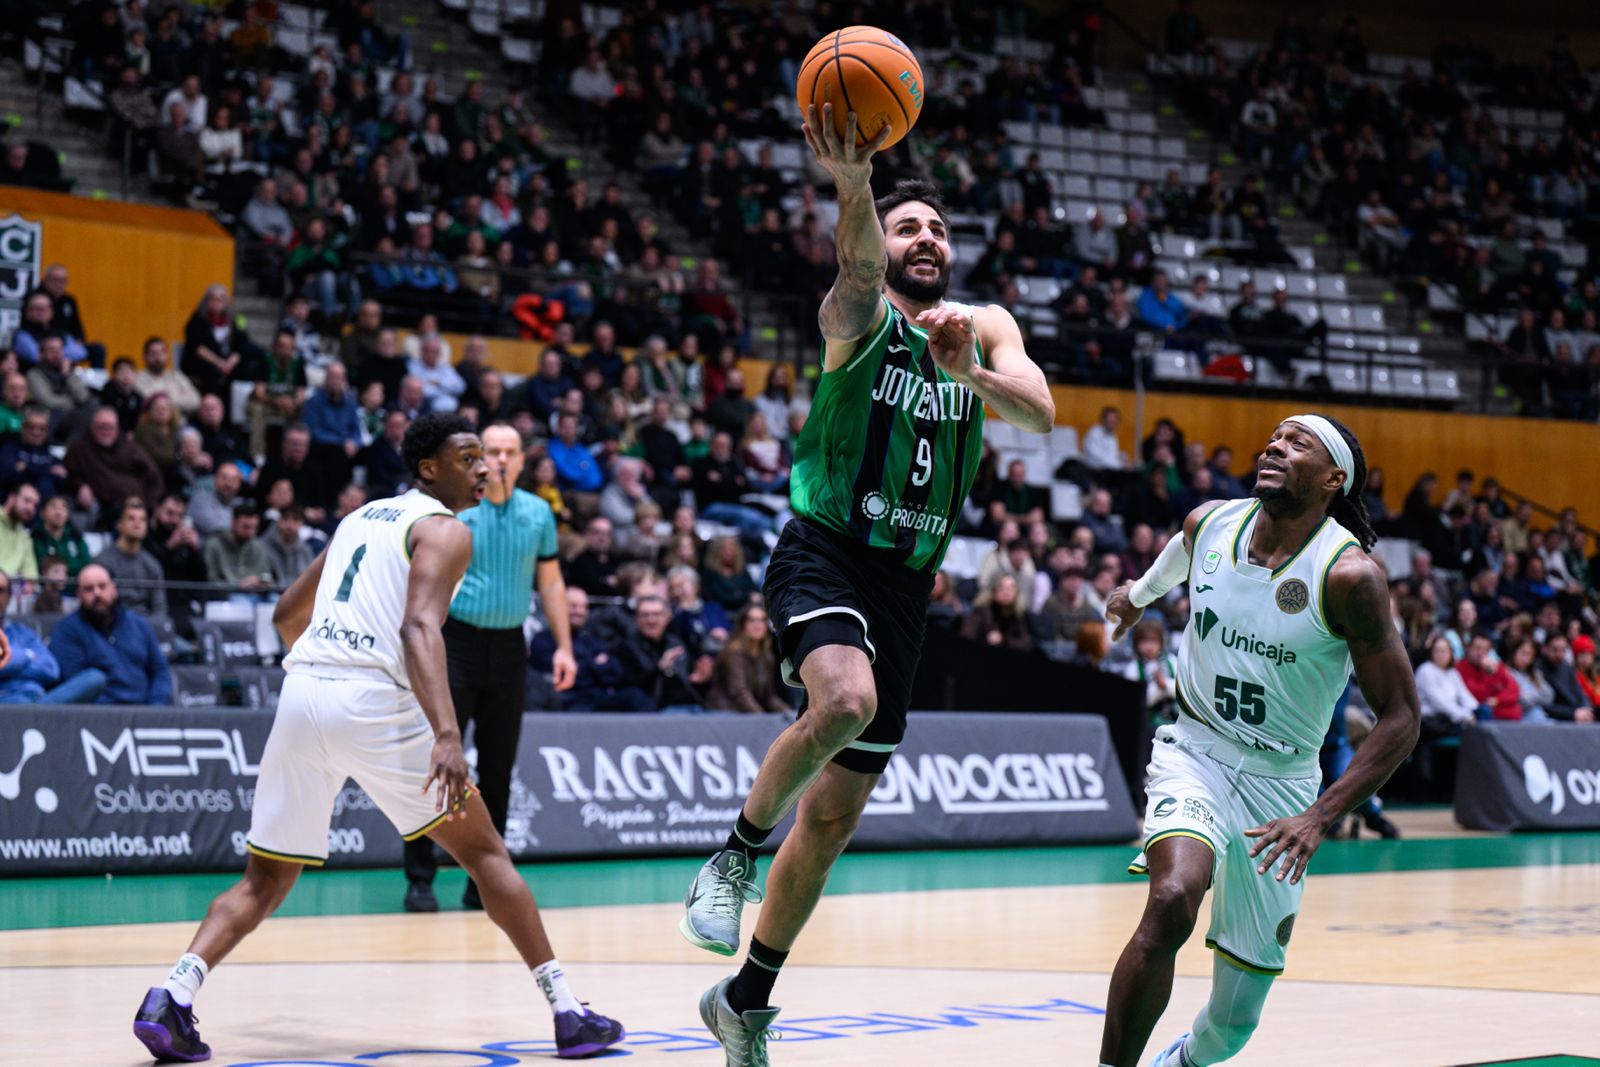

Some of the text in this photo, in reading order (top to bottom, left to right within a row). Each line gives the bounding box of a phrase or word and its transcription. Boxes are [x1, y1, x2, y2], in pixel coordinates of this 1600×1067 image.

[912, 438, 932, 487] 9
[334, 543, 366, 602] 1
[1221, 626, 1297, 666] Unicaja
[1214, 674, 1266, 726] 55
[94, 783, 233, 814] Soluciones
[0, 831, 192, 860] www.merlos.net
[224, 998, 1106, 1067] AMERESC
